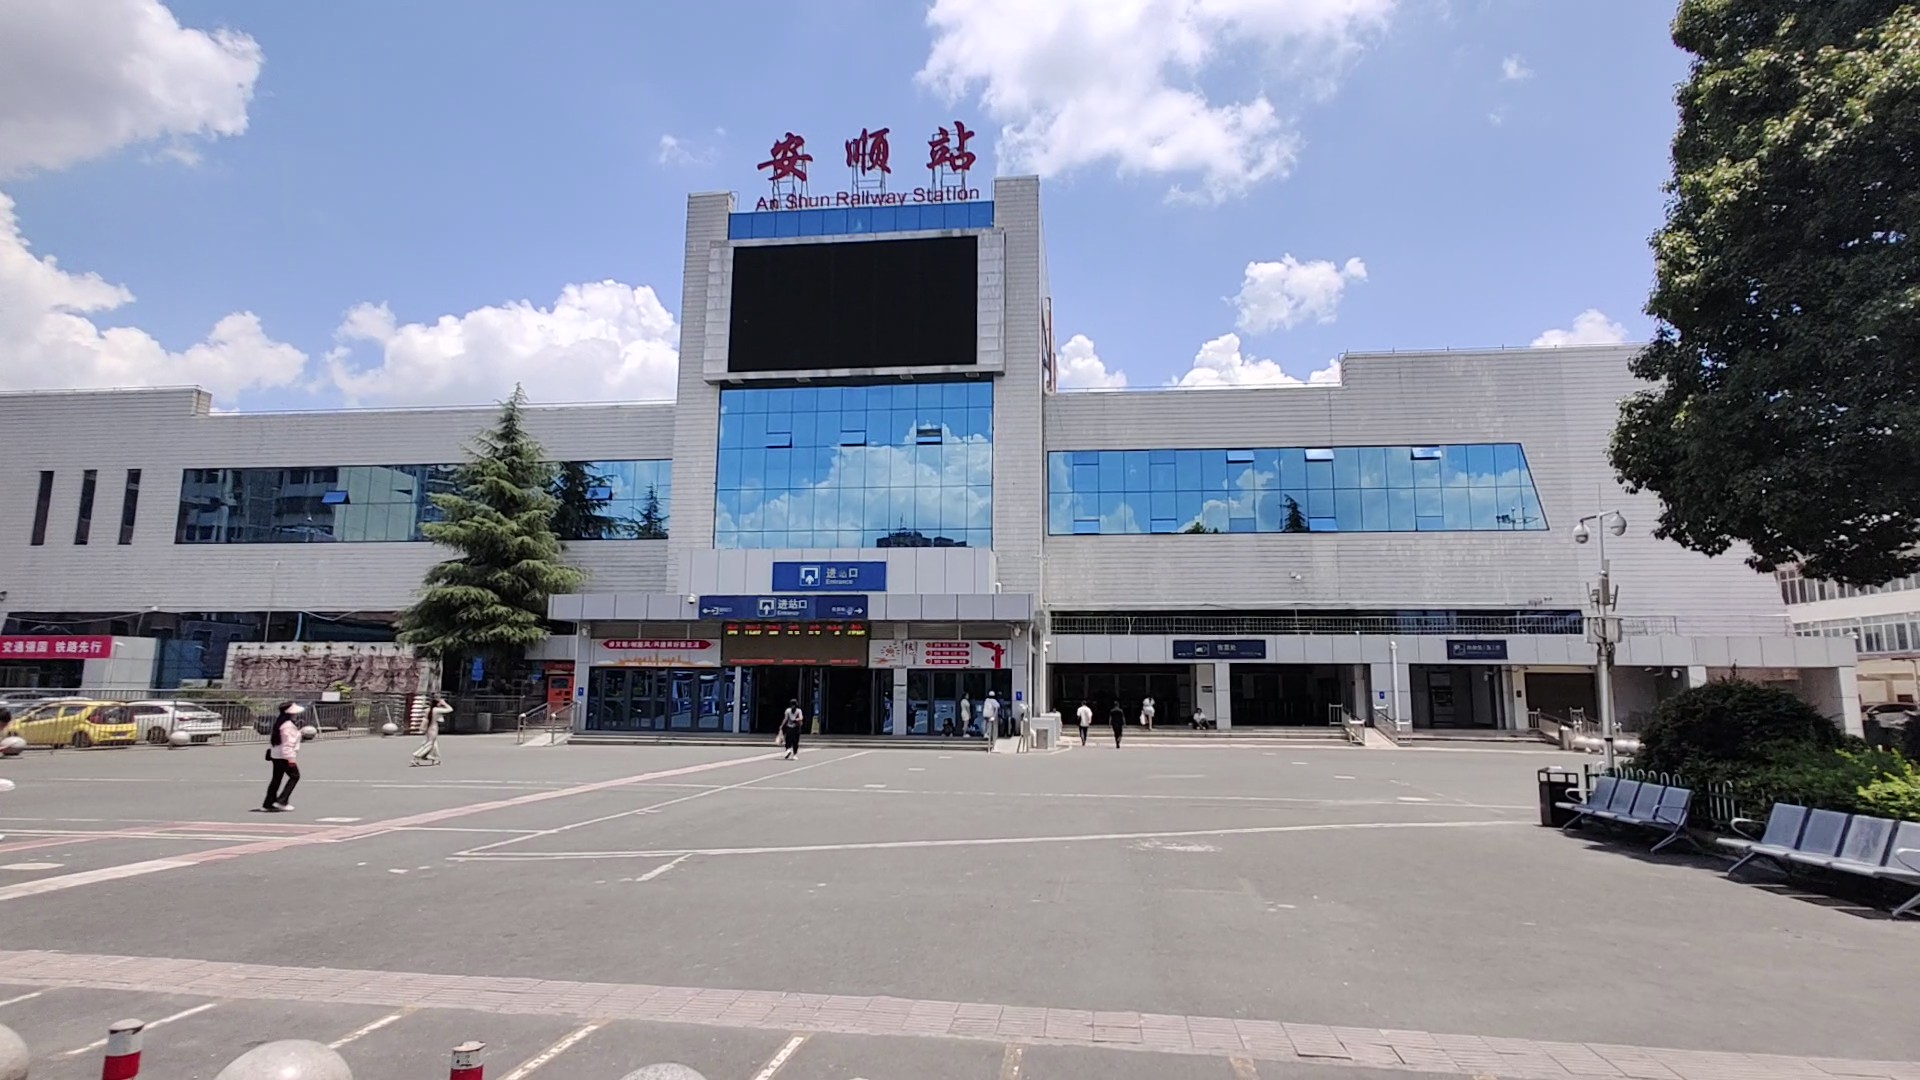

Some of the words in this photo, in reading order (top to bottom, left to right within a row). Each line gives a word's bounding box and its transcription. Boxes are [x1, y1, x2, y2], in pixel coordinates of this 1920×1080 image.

[757, 121, 977, 182] 安顺站
[756, 197, 779, 211] An
[785, 193, 830, 209] Shun
[836, 190, 907, 206] Railway
[913, 186, 979, 203] Station
[826, 567, 858, 578] 进站口
[777, 598, 808, 610] 进站口
[1, 641, 49, 653] 交通强国
[55, 641, 102, 653] 铁路先行
